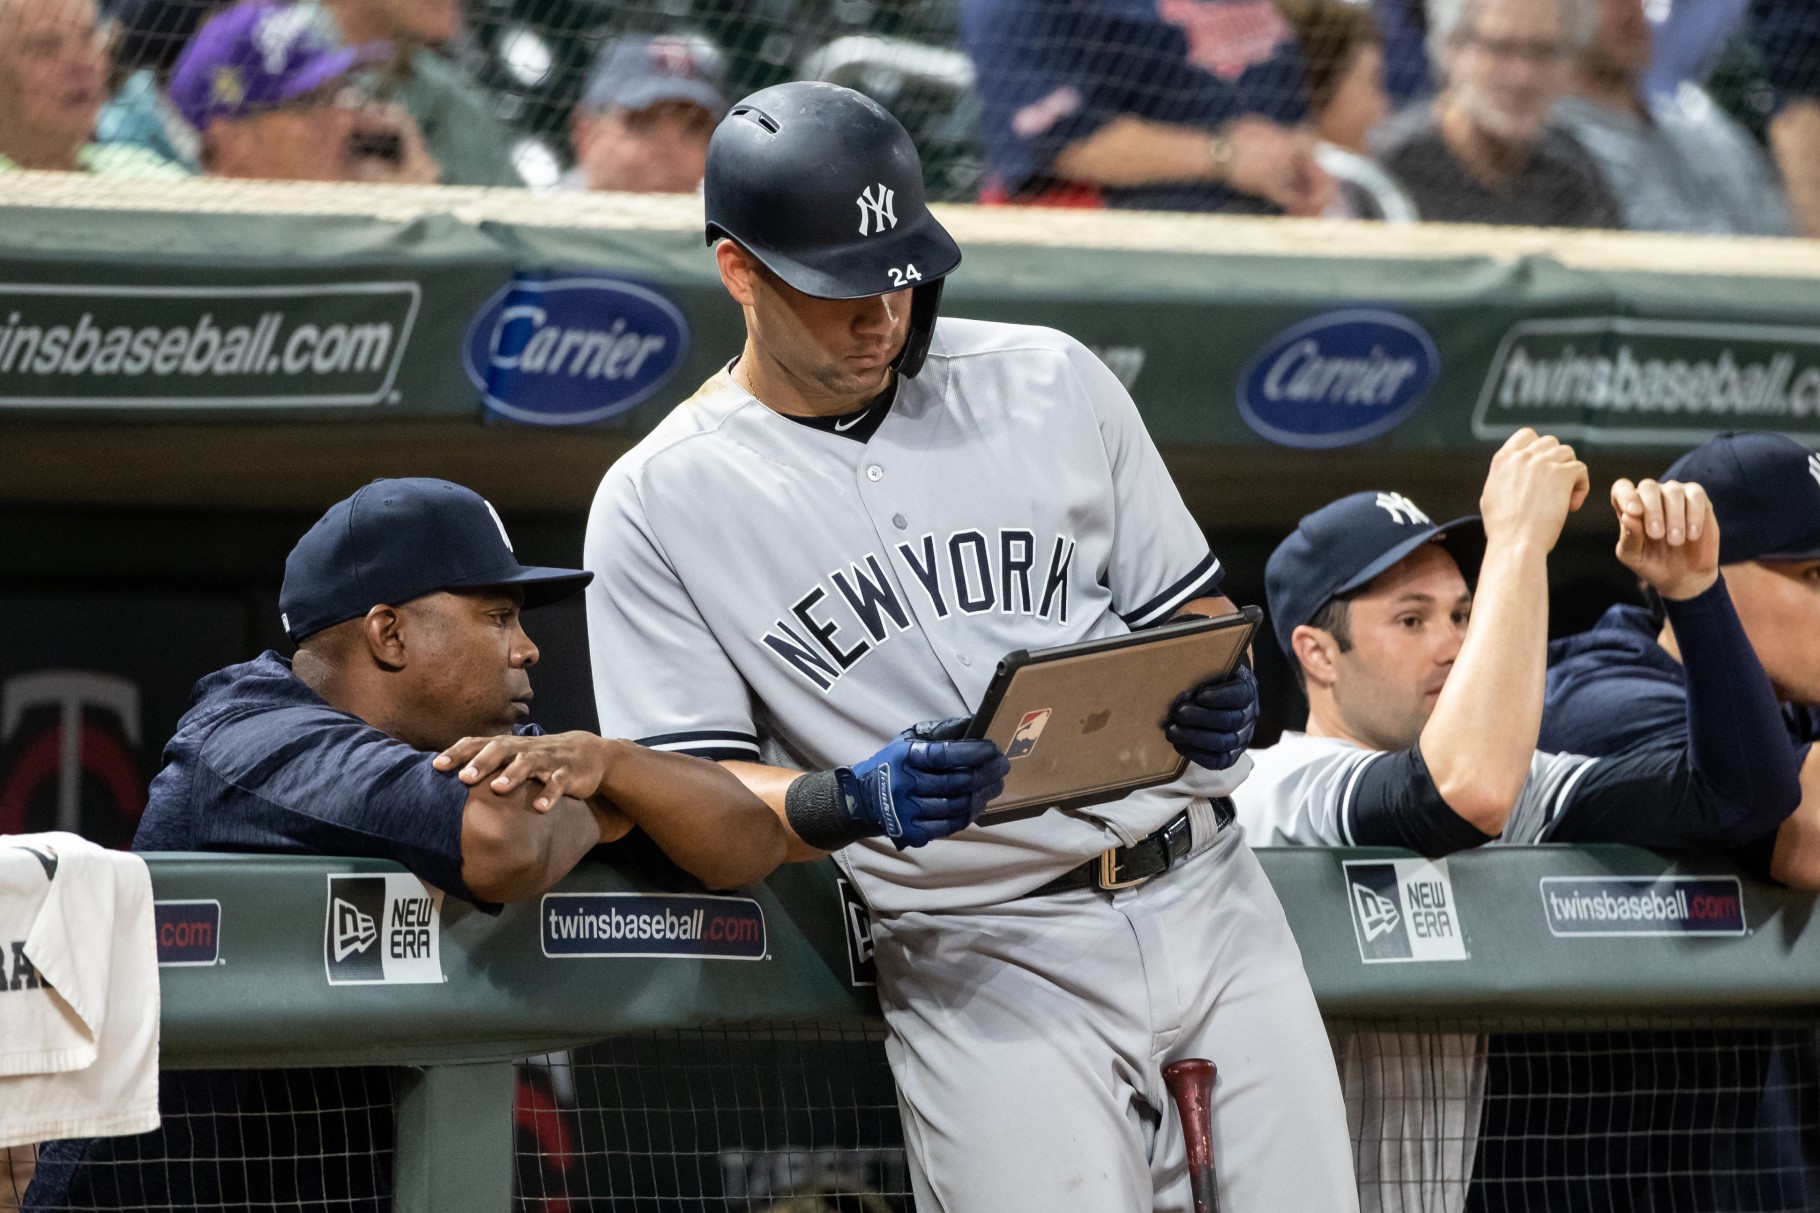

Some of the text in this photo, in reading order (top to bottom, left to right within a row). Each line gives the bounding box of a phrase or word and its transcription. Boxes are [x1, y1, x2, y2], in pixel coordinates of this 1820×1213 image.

[856, 182, 898, 237] NY
[887, 263, 922, 288] 24
[0, 310, 394, 378] insbaseball.com
[489, 304, 667, 380] Carrier
[1499, 346, 1820, 418] twinsbaseball.c
[759, 526, 1078, 695] NEW YORK
[1406, 881, 1447, 910] NEW
[1550, 888, 1738, 921] twinsbaseball.com
[391, 898, 434, 928] NEW
[549, 907, 760, 943] twinsbaseball.com
[1412, 910, 1453, 938] ERA
[390, 929, 431, 959] ERA
